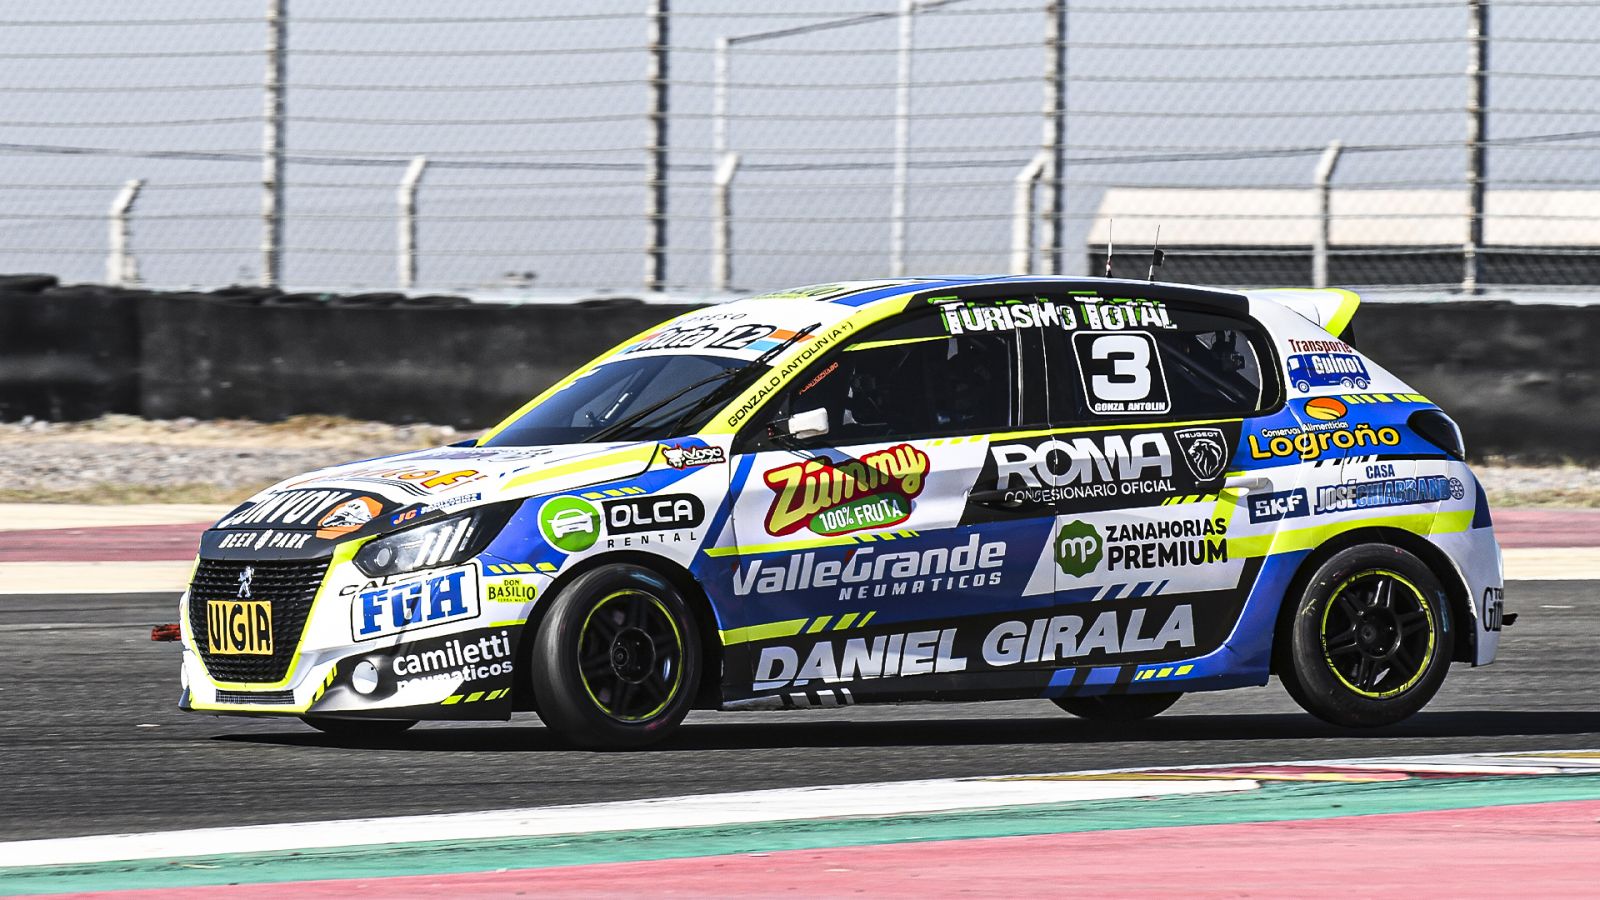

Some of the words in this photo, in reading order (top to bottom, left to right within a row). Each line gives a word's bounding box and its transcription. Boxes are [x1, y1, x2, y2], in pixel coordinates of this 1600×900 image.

[1288, 339, 1353, 354] Transporte
[1092, 335, 1151, 400] 3
[727, 376, 781, 428] GONZALO
[781, 336, 828, 379] ANTOLIN
[1095, 403, 1125, 411] GONZA
[1127, 402, 1166, 410] ANTOLIN
[1303, 421, 1349, 433] Alimenticias
[1248, 423, 1401, 460] Logroño
[991, 433, 1173, 490] ROMA
[1365, 464, 1396, 479] CASA
[1004, 483, 1118, 503] CONCESIONARIO
[1120, 479, 1176, 496] OFICIAL
[611, 499, 693, 528] OLCA
[818, 506, 854, 532] 100%
[854, 499, 903, 525] FRUTA
[1255, 494, 1303, 517] SKF
[218, 533, 257, 549] BEER
[268, 533, 312, 549] PARK
[607, 531, 697, 548] RENTAL
[1105, 518, 1227, 543] ZANAHORIAS
[1107, 538, 1227, 572] PREMIUM
[488, 586, 536, 600] BASILIO
[839, 572, 1002, 600] NEUMATICOS
[359, 571, 468, 635] FGH
[208, 604, 271, 651] VIGIA
[392, 631, 511, 676] camiletti
[753, 628, 967, 691] DANIEL
[982, 604, 1196, 667] GIRALA
